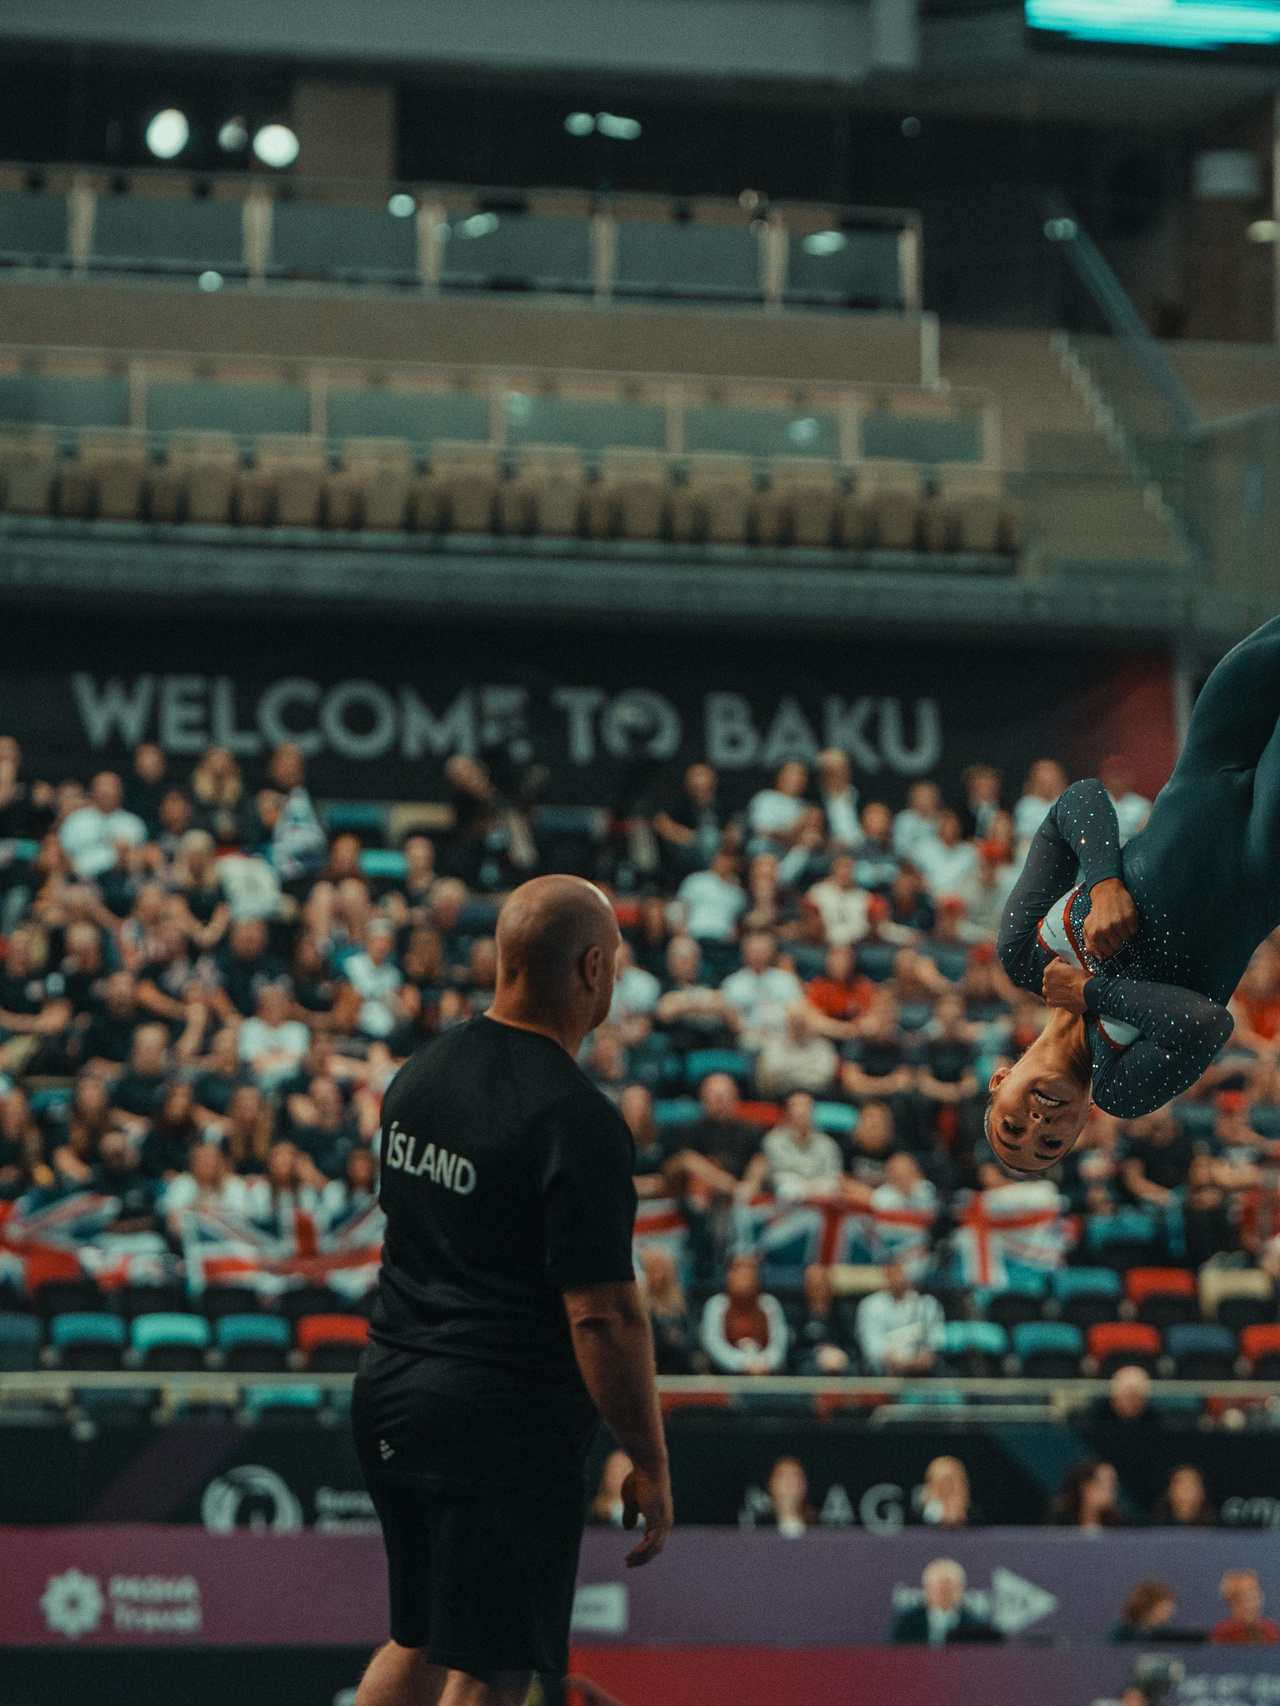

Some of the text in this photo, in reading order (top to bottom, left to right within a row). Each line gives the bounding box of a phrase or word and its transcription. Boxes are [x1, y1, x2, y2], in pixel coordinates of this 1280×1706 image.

[550, 684, 682, 764] TO
[704, 690, 942, 775] BAKU
[386, 1121, 477, 1196] ÍSLAND
